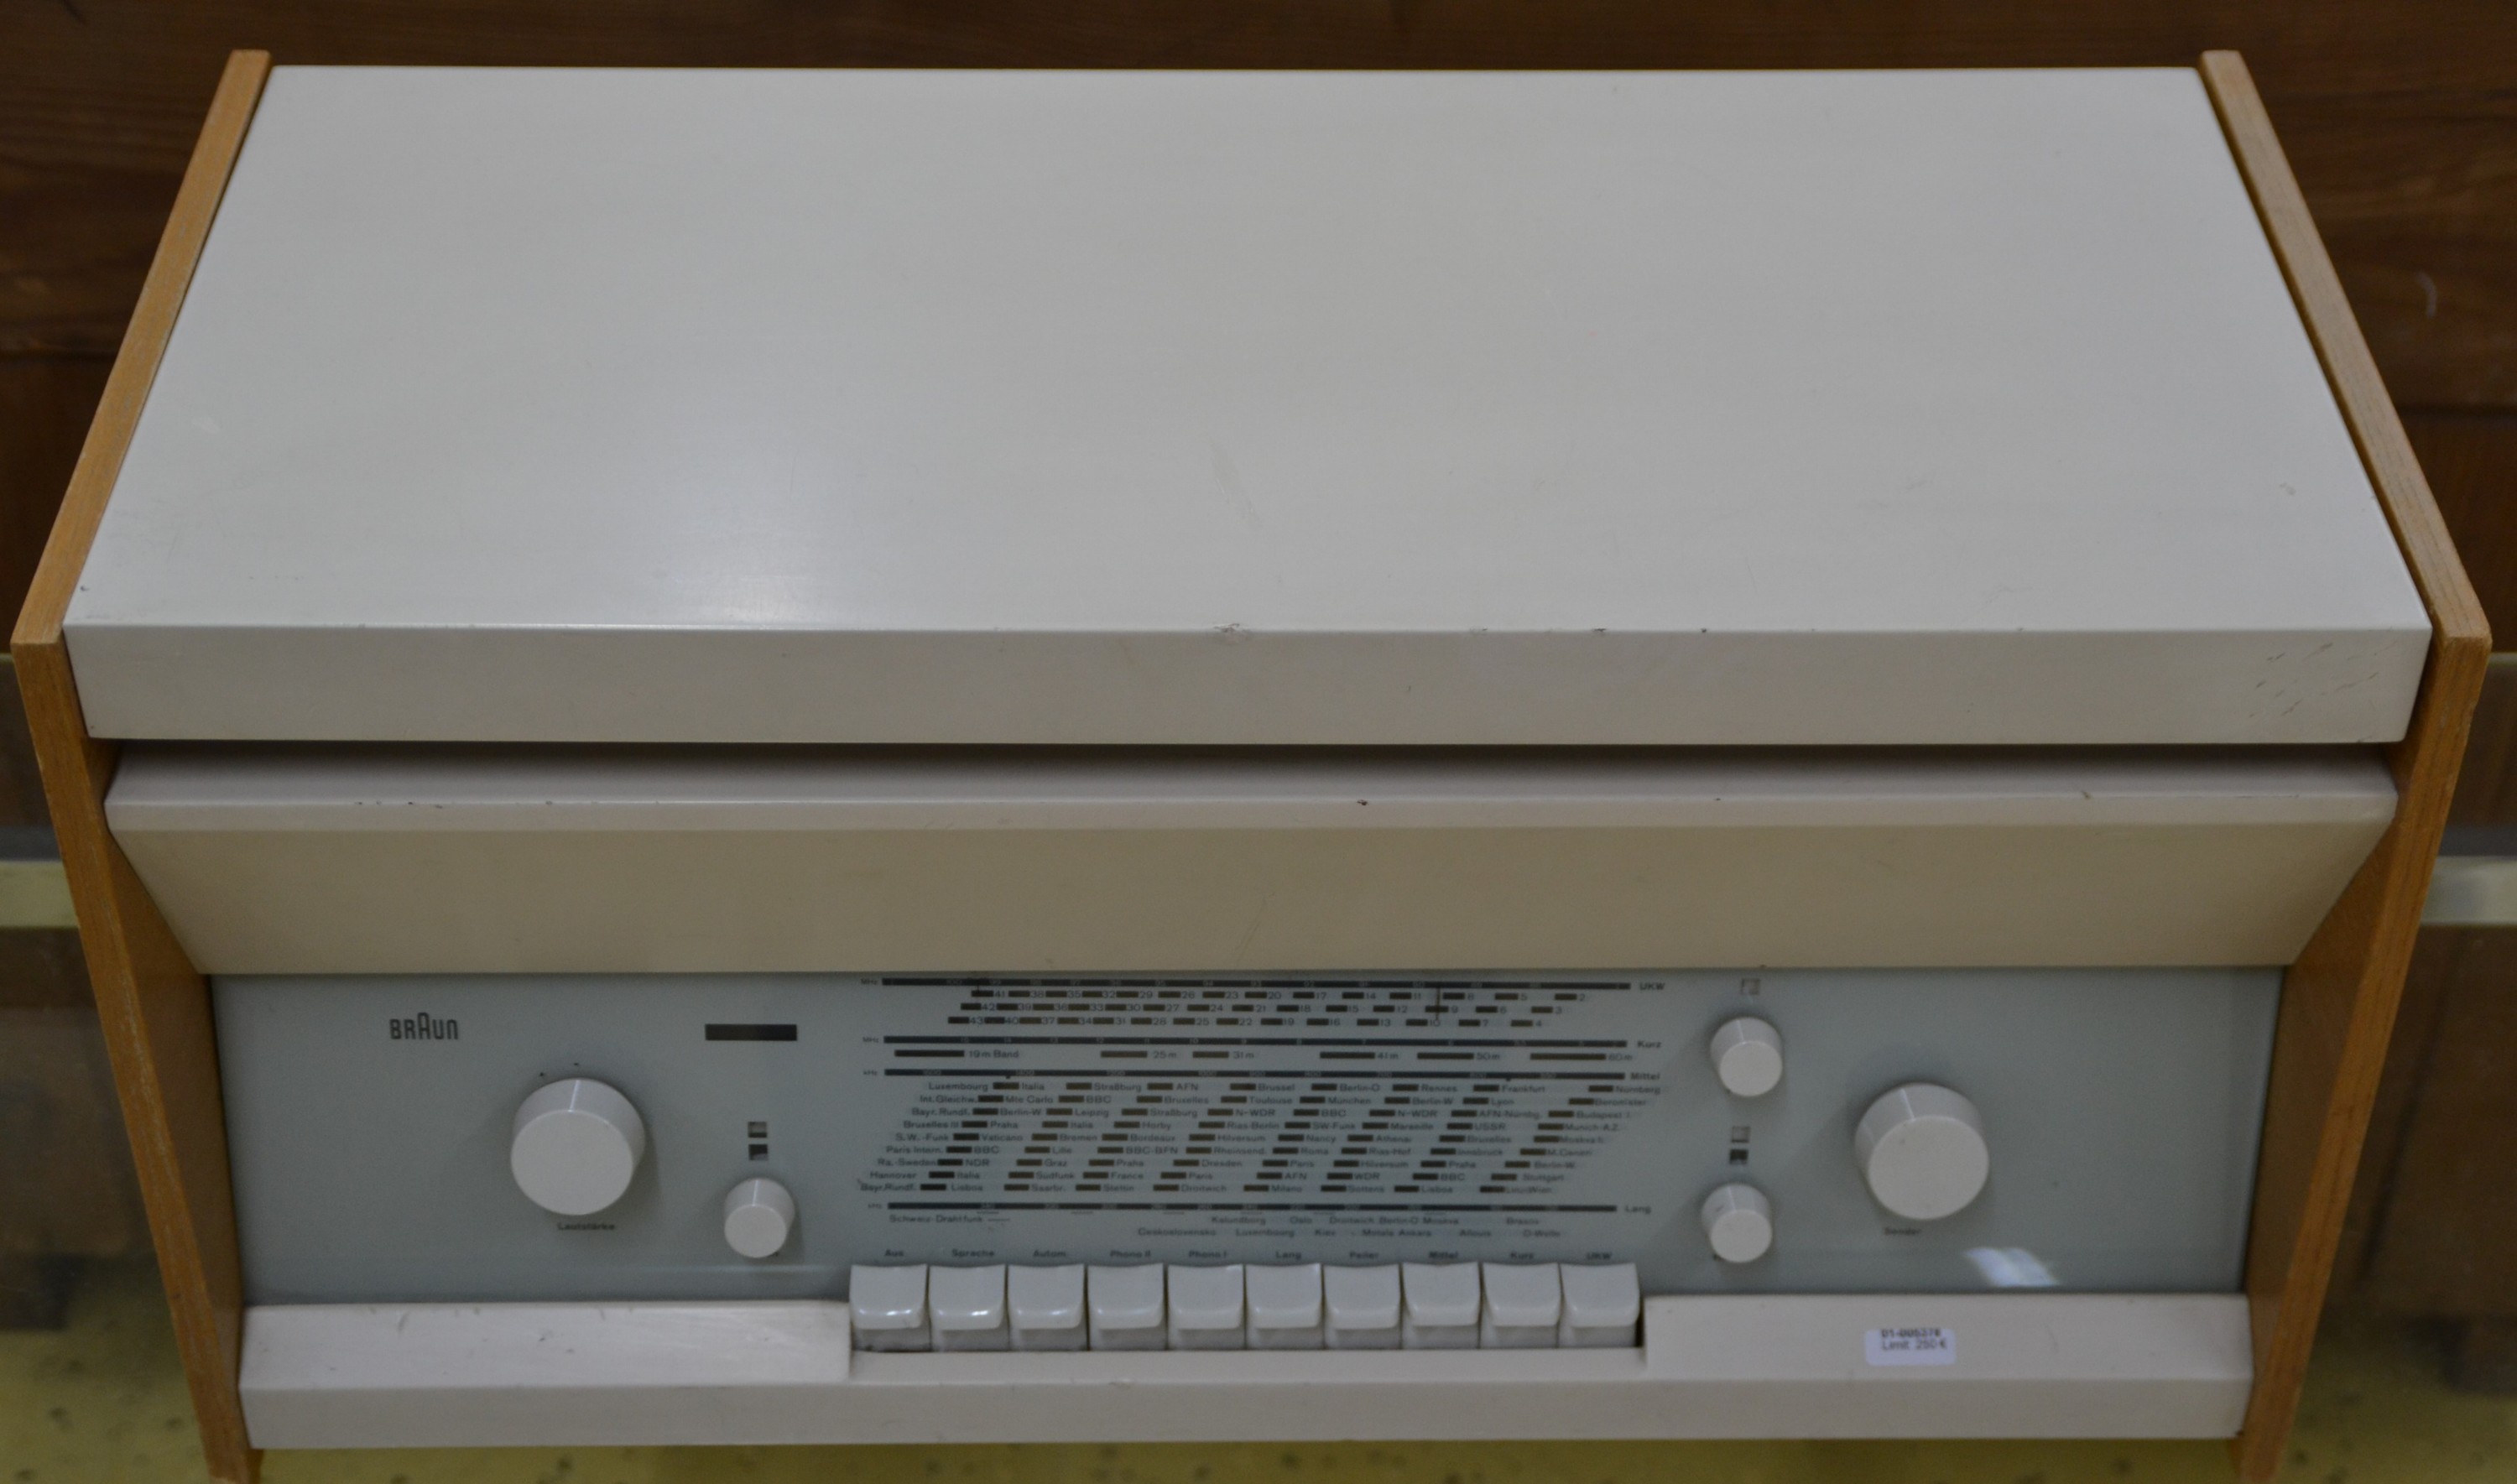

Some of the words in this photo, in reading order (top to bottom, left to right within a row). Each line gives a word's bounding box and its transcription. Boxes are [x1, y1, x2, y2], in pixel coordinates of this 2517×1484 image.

[389, 1013, 459, 1041] BRAUN
[929, 1083, 988, 1091] Luxembourg
[1076, 1109, 1109, 1118] Leipzig
[1306, 1135, 1336, 1143] Nancy
[1625, 1205, 1651, 1214] Lang
[952, 1249, 994, 1257] Sprache
[1276, 1251, 1301, 1260] Lang
